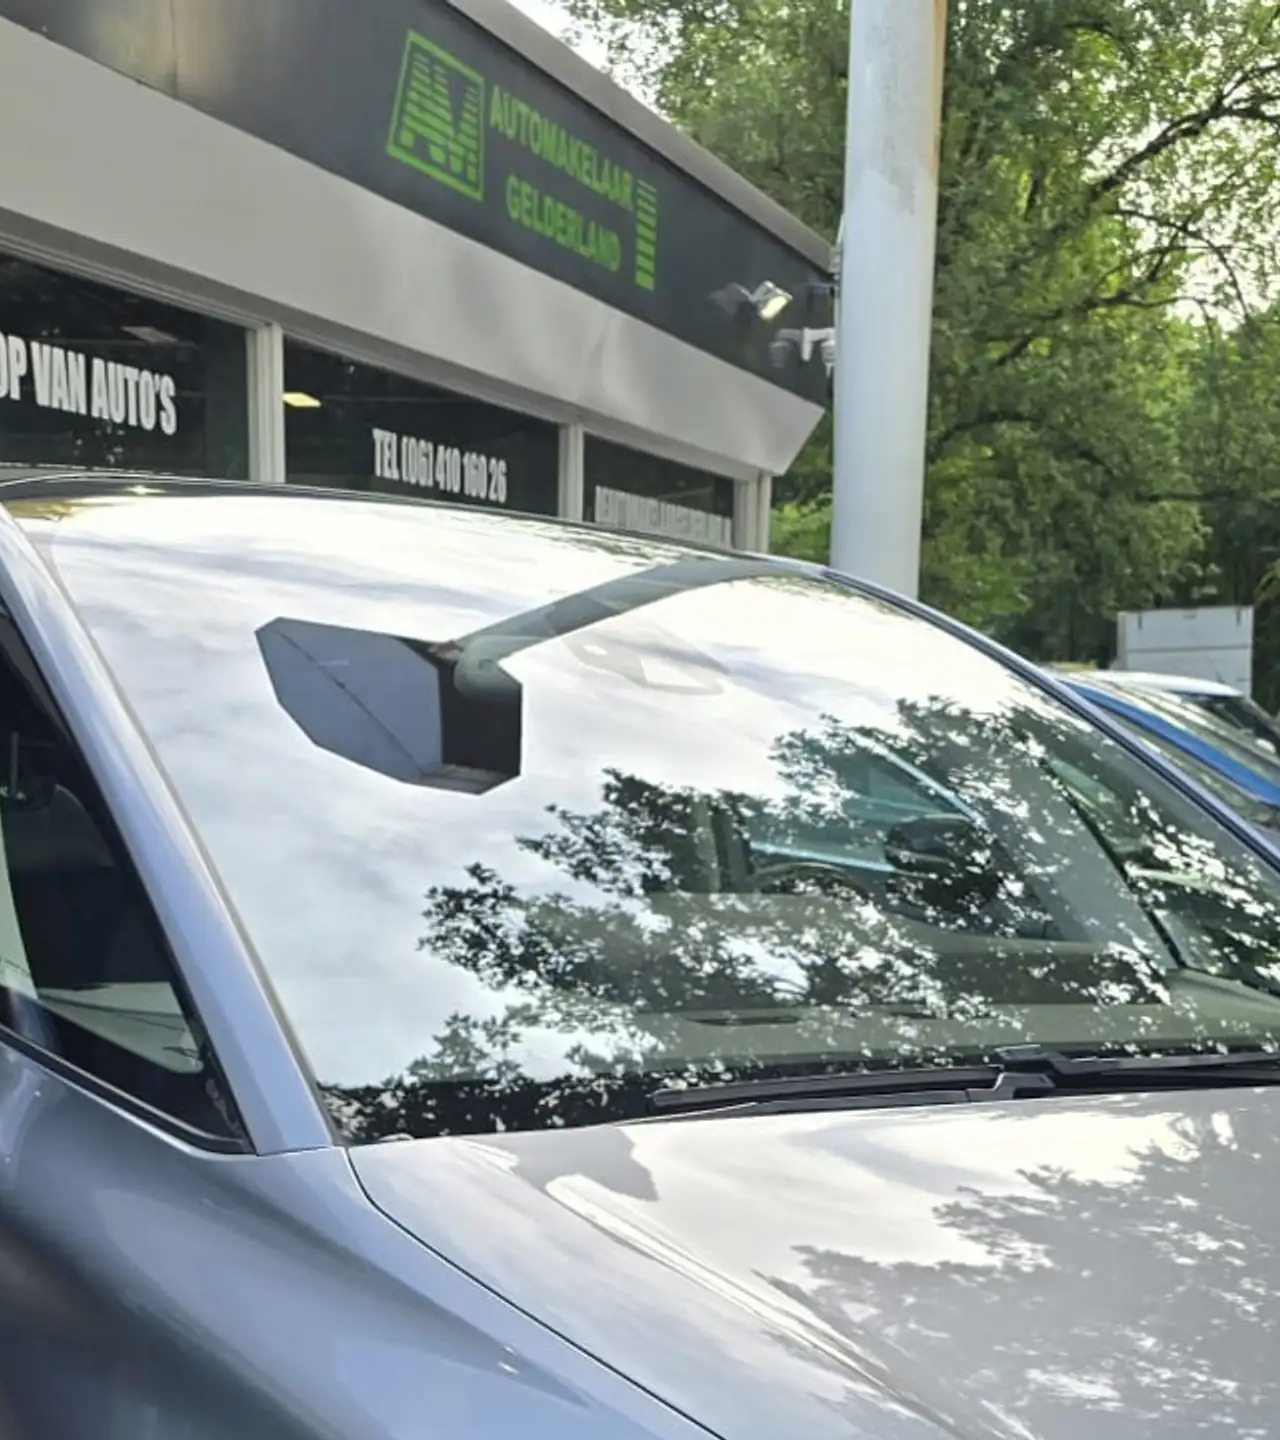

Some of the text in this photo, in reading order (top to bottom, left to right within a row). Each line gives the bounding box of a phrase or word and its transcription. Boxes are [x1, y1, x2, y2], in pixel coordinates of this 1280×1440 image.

[489, 84, 634, 213] AUTOMAKELAAR
[506, 173, 621, 272] GELDERLAND
[31, 343, 87, 417] VAN
[91, 357, 177, 436] AUTO'S
[372, 427, 400, 481] TEL
[434, 444, 461, 494] 410
[488, 456, 507, 504] 26
